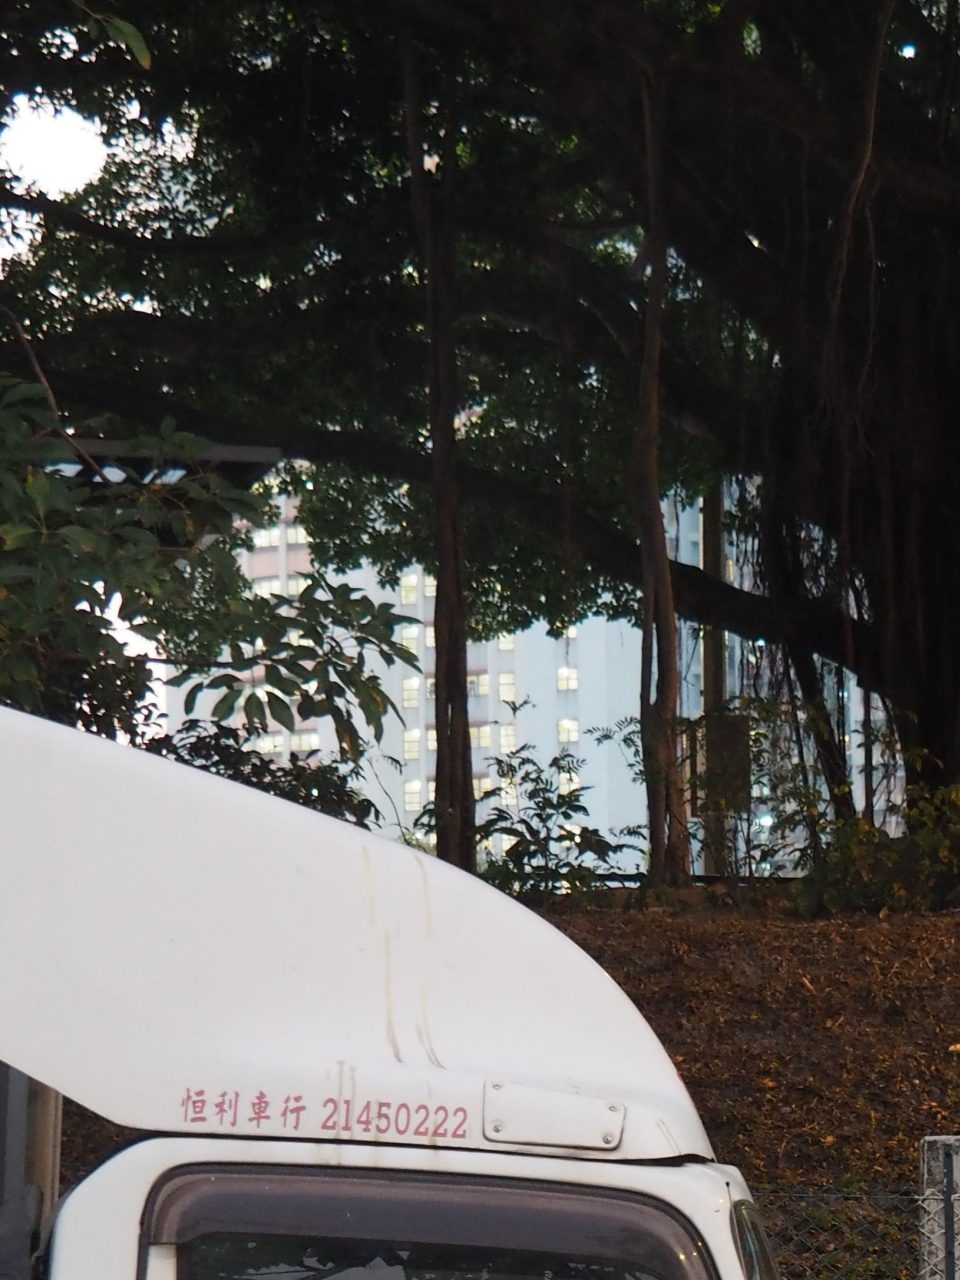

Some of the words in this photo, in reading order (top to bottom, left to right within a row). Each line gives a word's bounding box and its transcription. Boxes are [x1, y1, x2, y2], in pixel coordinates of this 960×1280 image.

[181, 1088, 308, 1131] 恒利車行
[320, 1097, 469, 1139] 21450222
